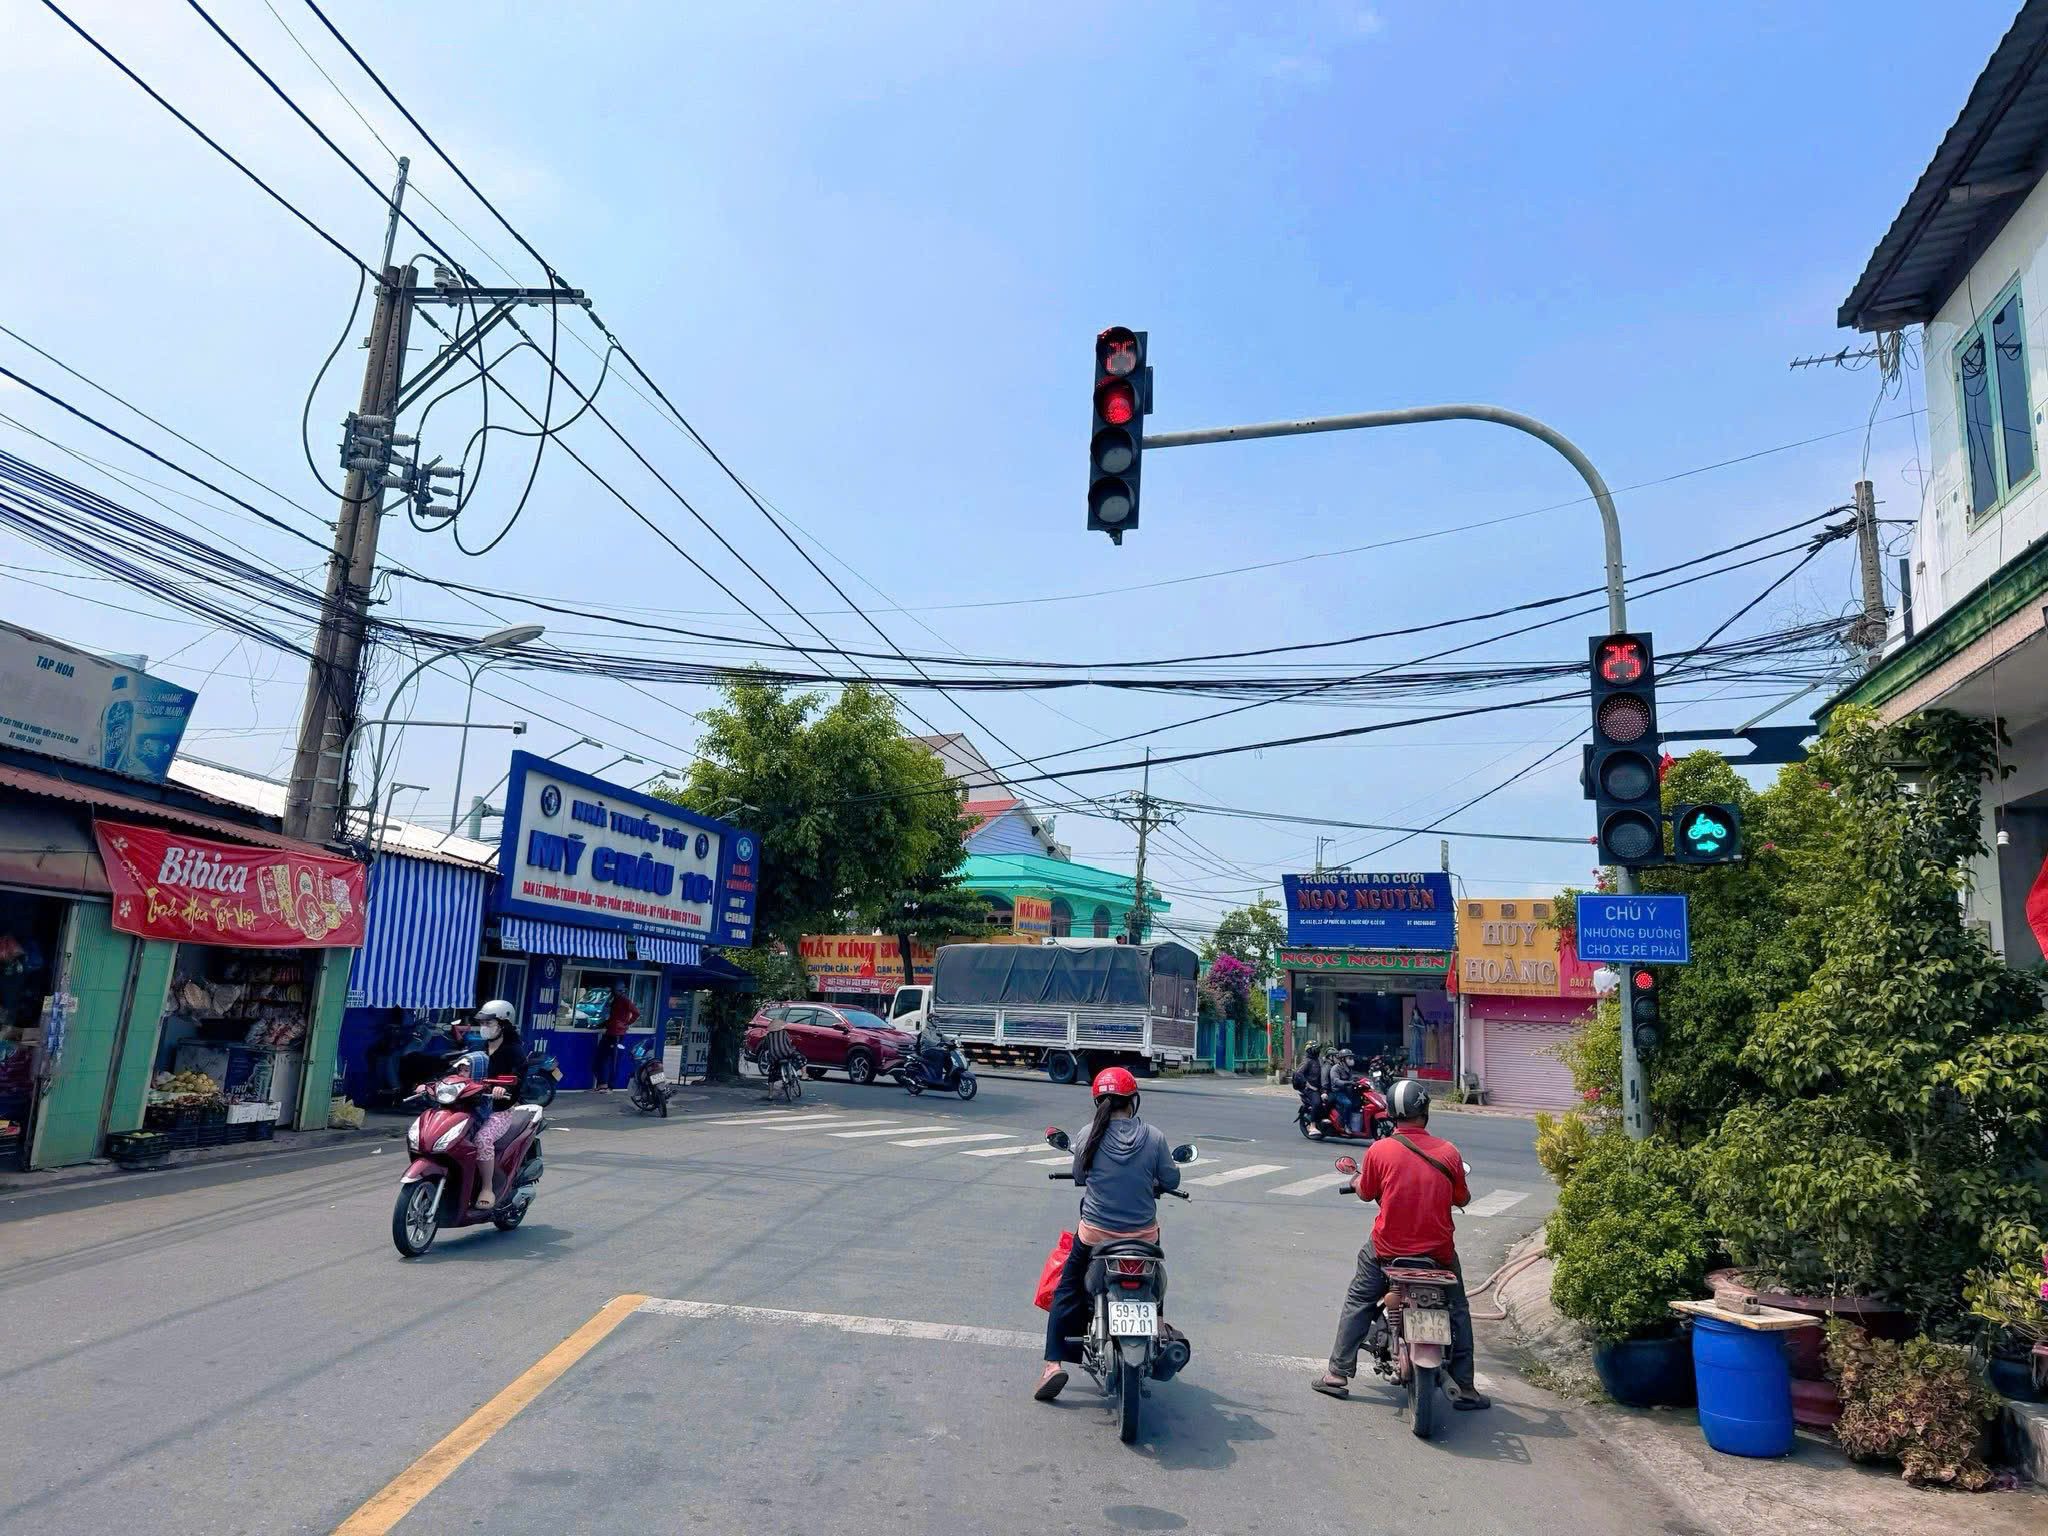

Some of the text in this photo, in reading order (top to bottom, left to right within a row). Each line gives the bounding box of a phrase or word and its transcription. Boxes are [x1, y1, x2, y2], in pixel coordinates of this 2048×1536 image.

[610, 813, 660, 842] THUỐC
[158, 847, 248, 893] Bibica
[527, 830, 586, 875] MỸ
[592, 847, 675, 896] CHÂU
[1297, 889, 1349, 915] NGỌC
[1605, 901, 1657, 921] CHÚ Ý
[1481, 922, 1537, 946] HUY
[1638, 925, 1681, 939] ĐƯỜNG
[800, 937, 833, 958] MẮT
[1587, 944, 1610, 955] CHO
[1614, 945, 1629, 955] XE
[1650, 943, 1680, 956] PHẢI
[1281, 952, 1341, 968] NGỌC
[1464, 952, 1556, 985] HOÀNG
[532, 1010, 555, 1030] THUỐC
[1116, 1304, 1150, 1318] 59-Y3
